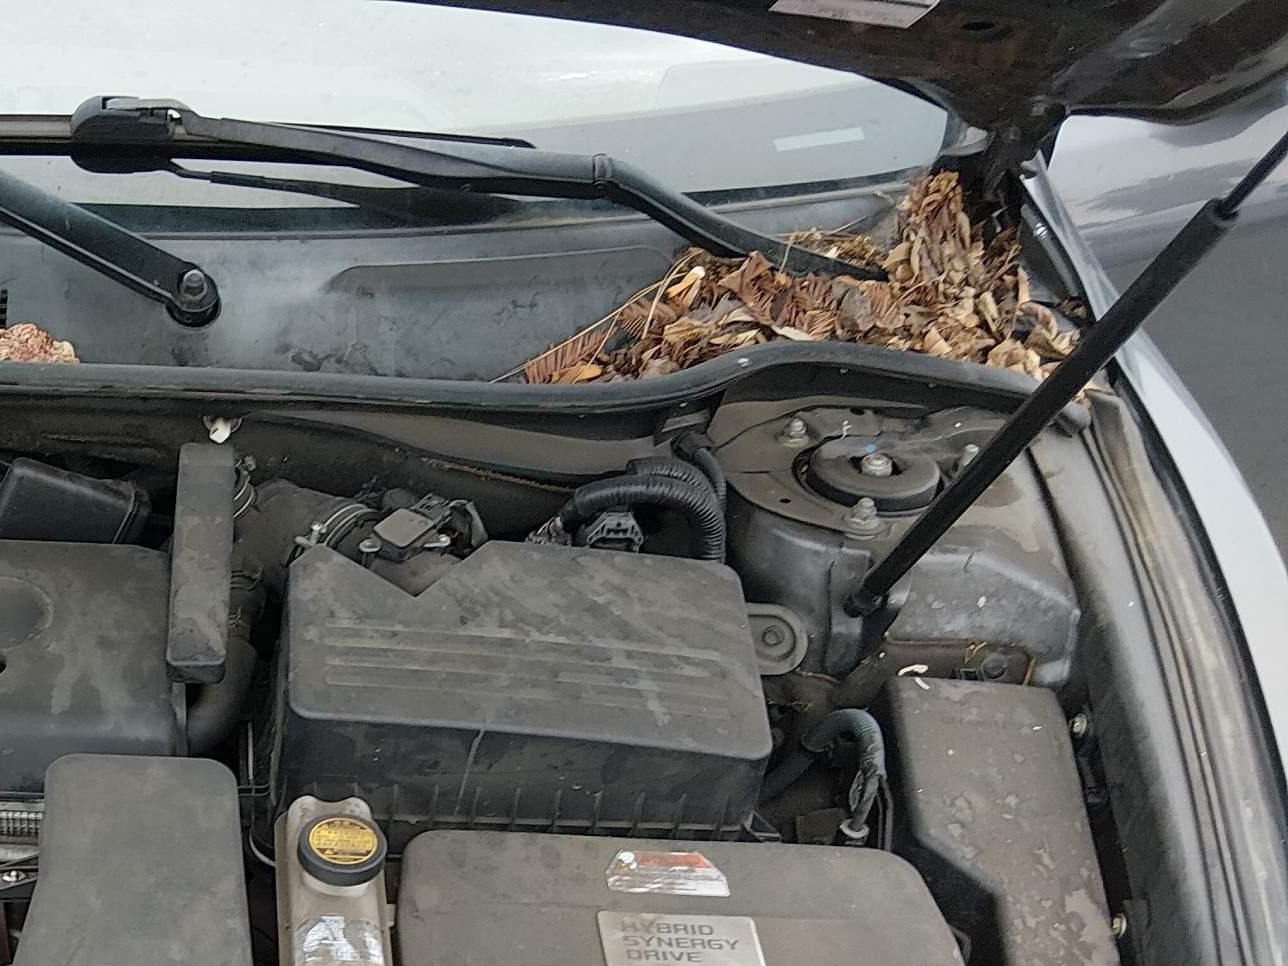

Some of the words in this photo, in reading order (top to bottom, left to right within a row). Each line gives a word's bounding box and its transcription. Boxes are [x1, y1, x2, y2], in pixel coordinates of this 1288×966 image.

[620, 918, 714, 936] HYBRID
[623, 936, 740, 951] SYNERGY
[626, 949, 703, 963] DRIVE
